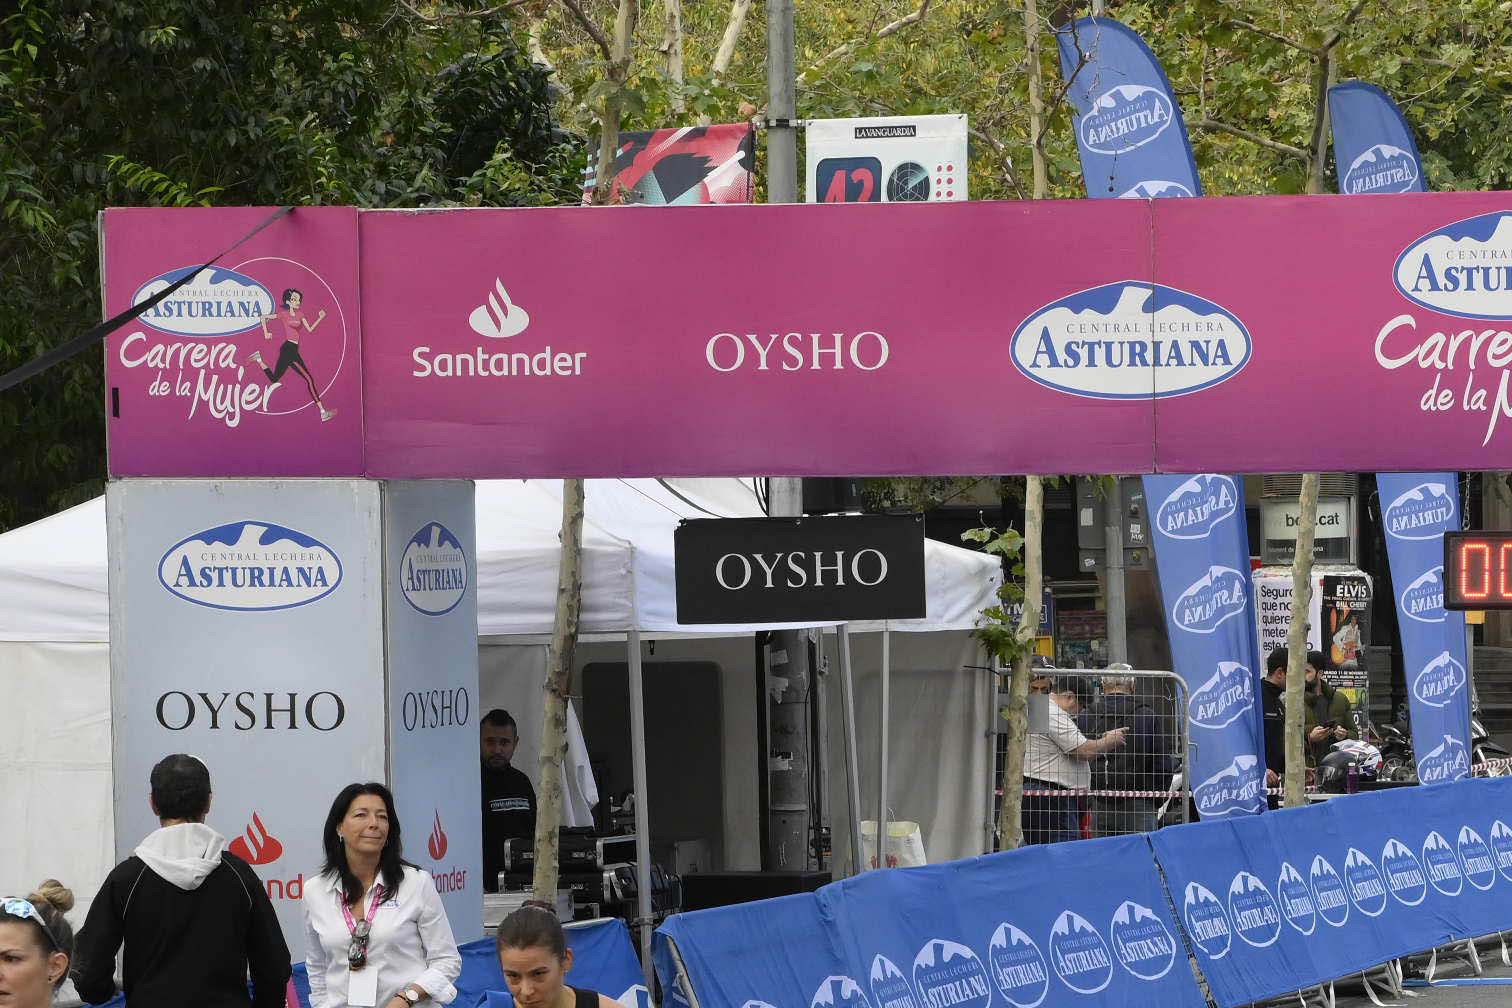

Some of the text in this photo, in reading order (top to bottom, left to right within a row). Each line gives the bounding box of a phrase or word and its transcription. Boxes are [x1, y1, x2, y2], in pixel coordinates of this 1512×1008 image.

[143, 291, 263, 319] ASTURIANA
[171, 289, 208, 298] ENTRAL
[1066, 321, 1225, 334] CENTRAL LECHERA
[119, 331, 237, 369] Carrera
[412, 345, 588, 377] Santander
[705, 331, 890, 372] OYSHO
[1029, 325, 1233, 369] ASTURIANA
[149, 365, 282, 428] de la Mujer
[1420, 372, 1455, 411] de
[1462, 372, 1487, 411] la
[172, 554, 330, 589] ASTURIANA
[200, 552, 323, 562] CENTRAL LECHERA
[715, 548, 888, 590] OYSHO
[406, 557, 464, 593] ASTURIANA
[1336, 584, 1367, 598] ELVIS
[1261, 601, 1278, 613] que
[156, 691, 345, 731] OYSHO
[403, 687, 469, 732] OYSHO
[431, 866, 467, 895] tander
[994, 957, 1046, 990] ASTURIANA
[1055, 944, 1110, 976] ASTURIANA
